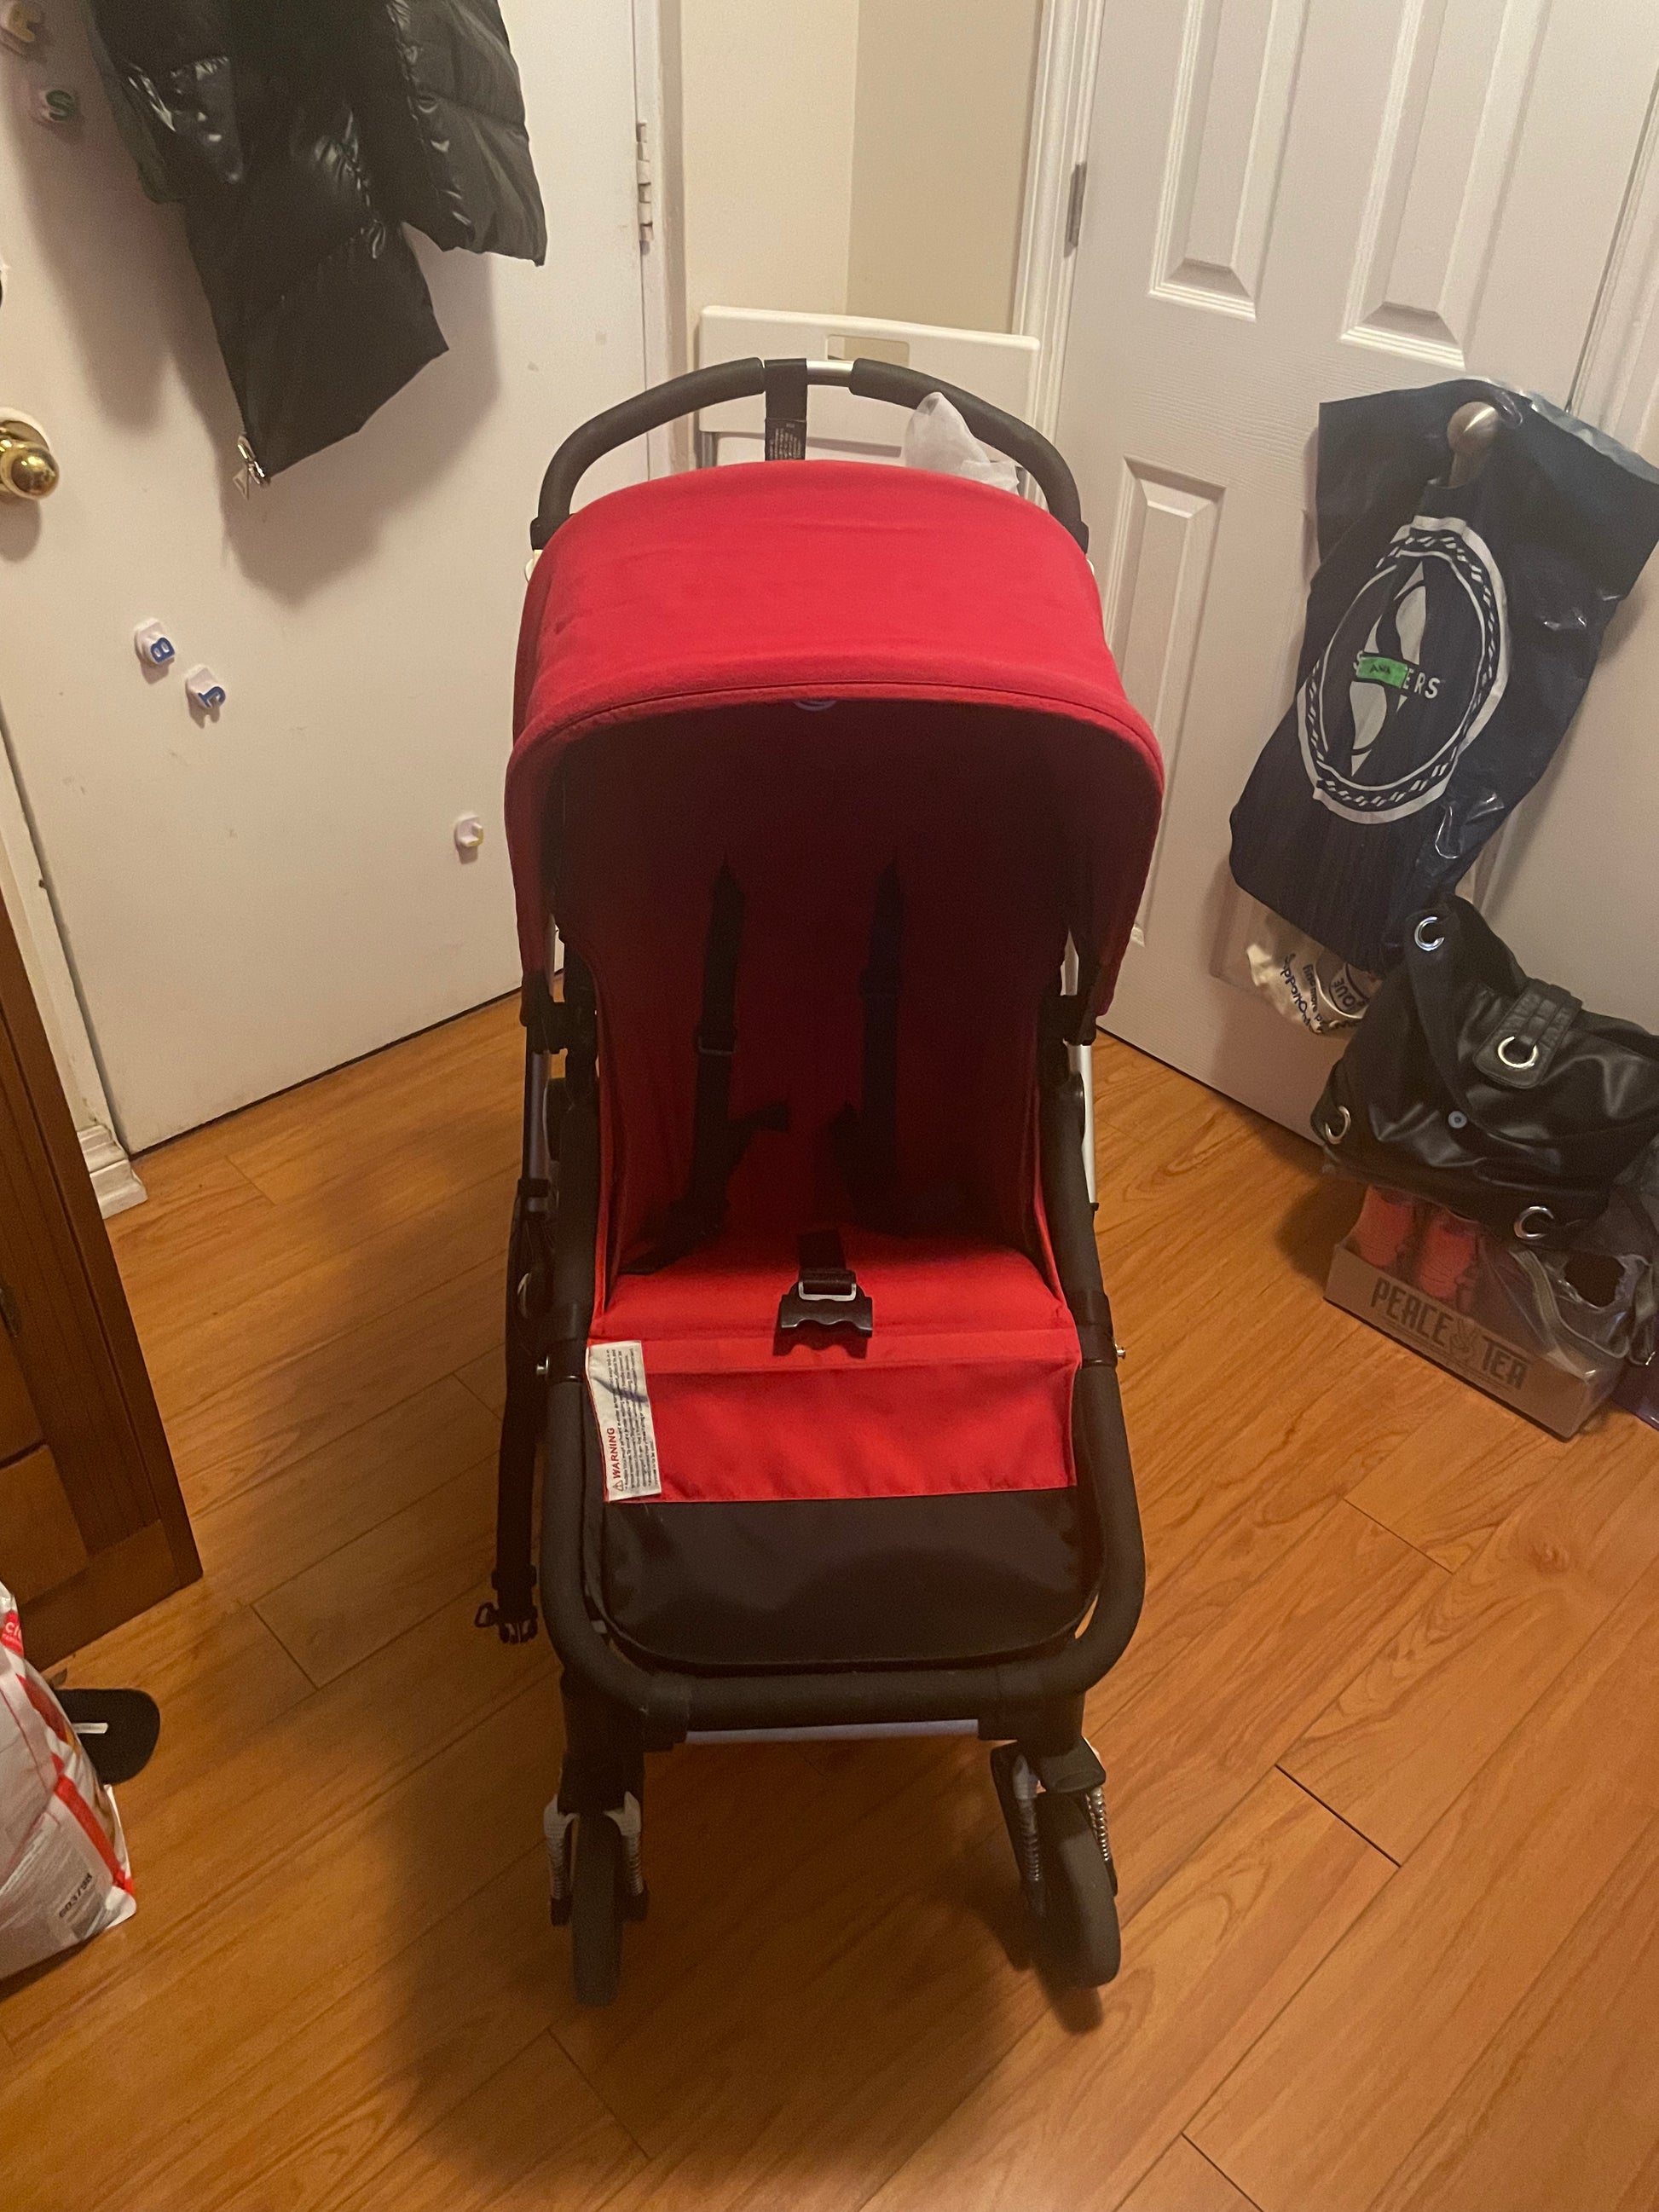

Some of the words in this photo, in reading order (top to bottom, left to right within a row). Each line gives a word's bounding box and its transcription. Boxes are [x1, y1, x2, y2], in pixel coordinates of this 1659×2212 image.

[150, 637, 176, 663] B
[1370, 1277, 1454, 1347] PEACE
[1483, 1335, 1529, 1389] TEA
[606, 1427, 621, 1479] WARNING
